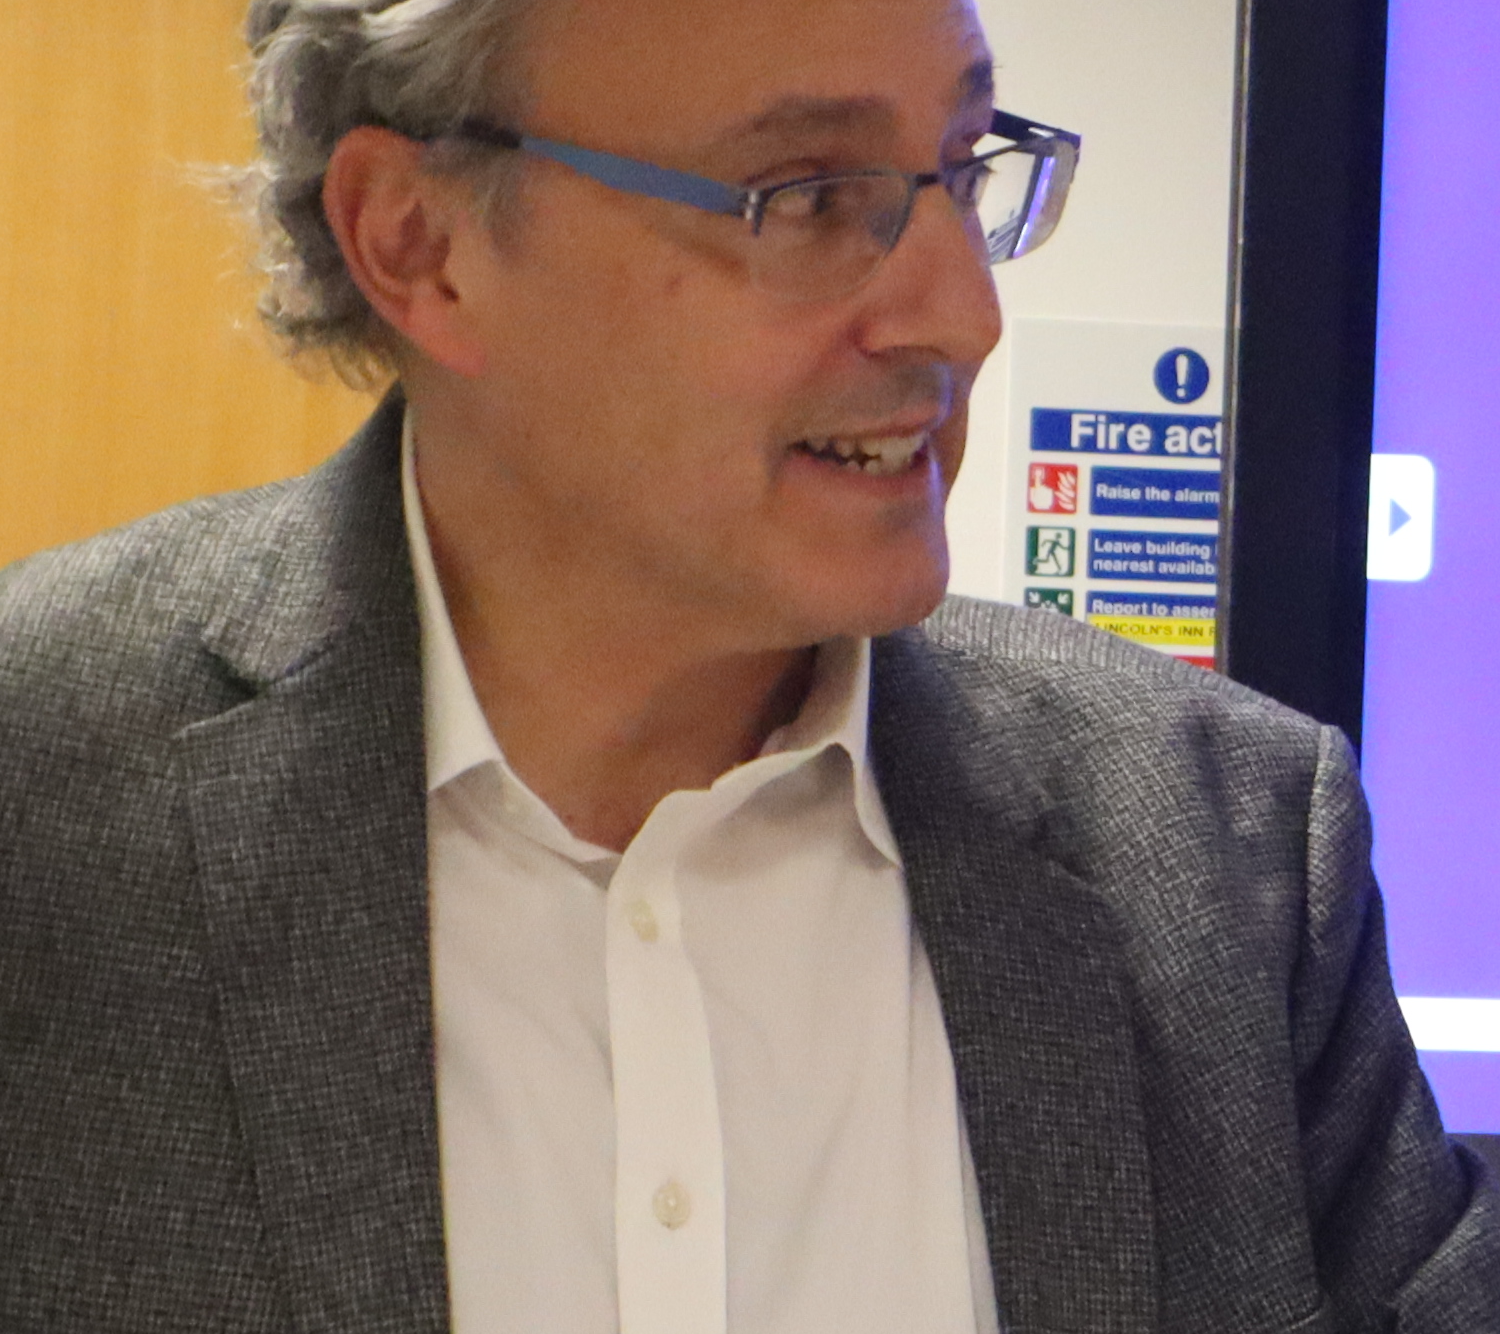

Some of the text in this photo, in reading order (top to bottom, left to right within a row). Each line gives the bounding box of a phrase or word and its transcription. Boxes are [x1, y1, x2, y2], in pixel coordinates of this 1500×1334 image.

[1070, 414, 1152, 452] Fire
[1096, 483, 1219, 504] Raise the alarm
[1094, 538, 1142, 554] Leave
[1146, 541, 1210, 560] building
[1093, 559, 1155, 573] nearest
[1092, 599, 1148, 616] Report
[1151, 603, 1169, 616] to
[1178, 626, 1204, 637] INN
